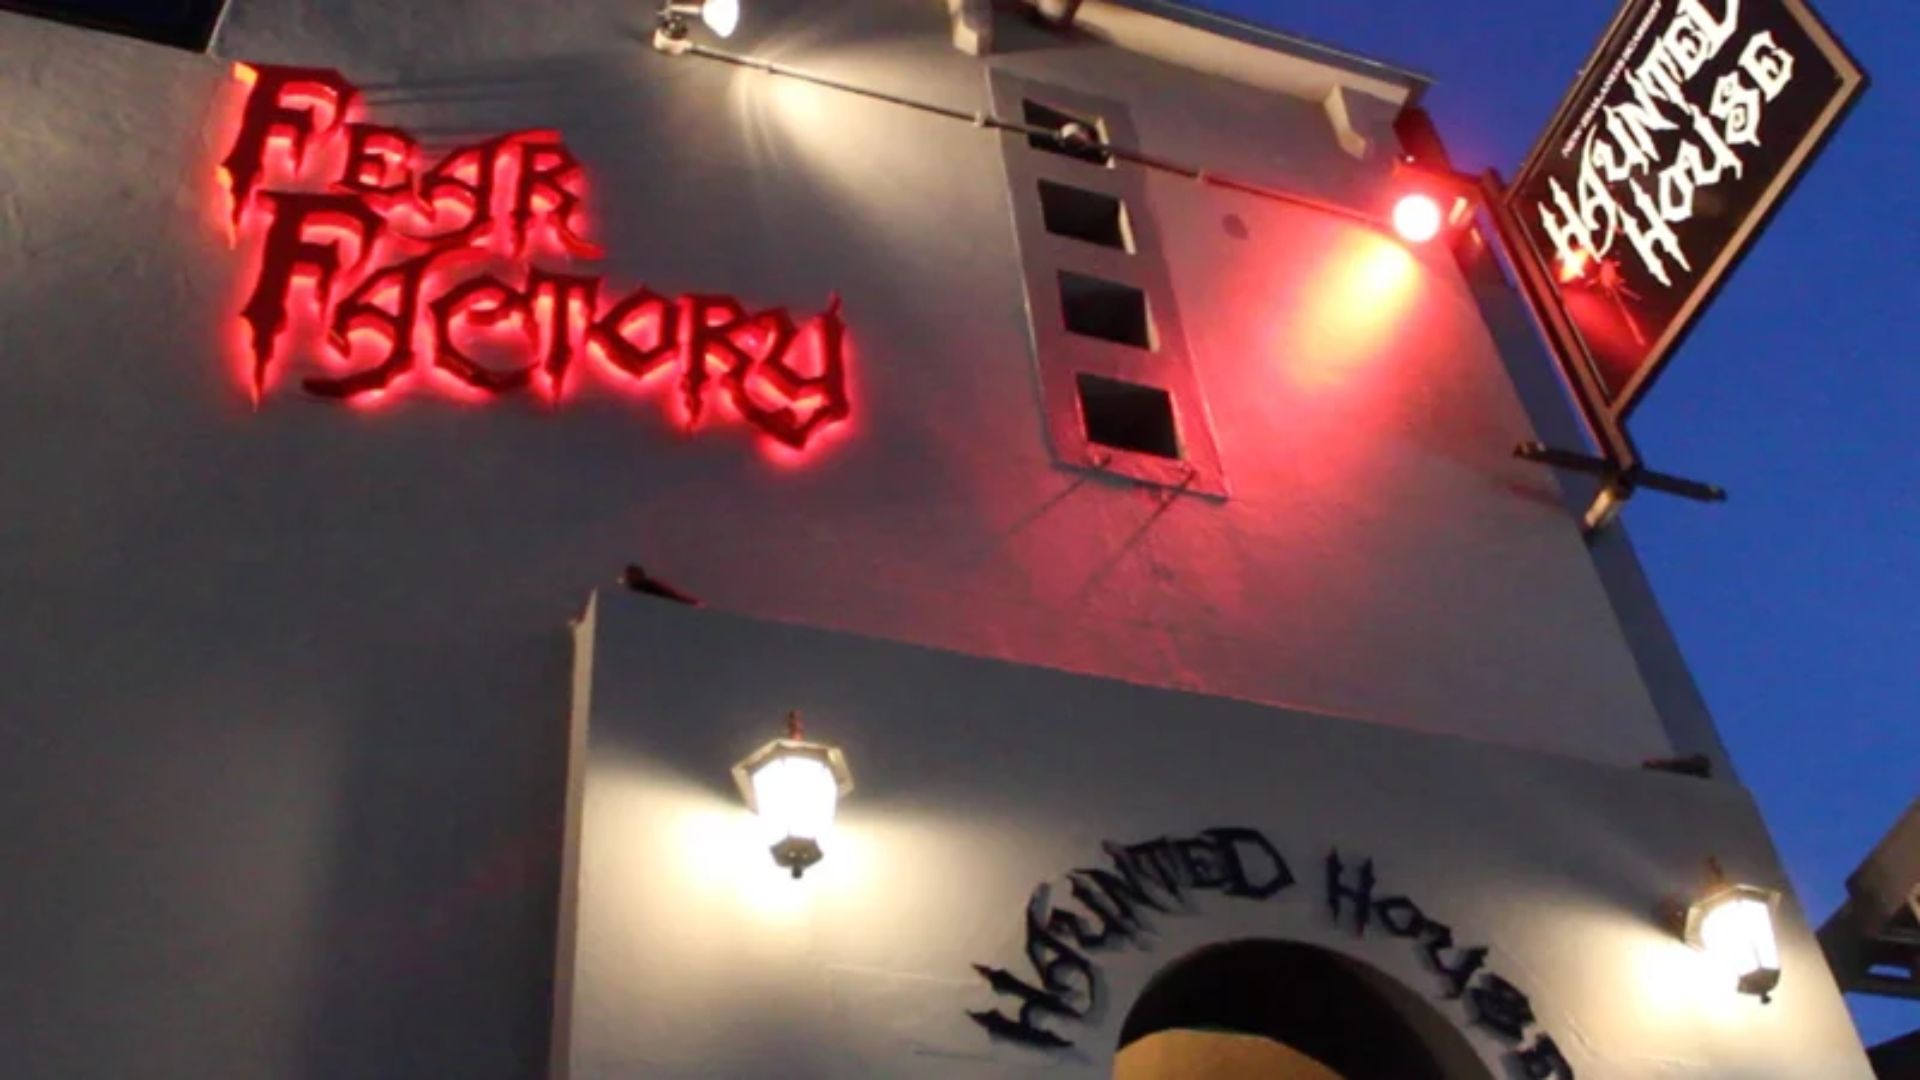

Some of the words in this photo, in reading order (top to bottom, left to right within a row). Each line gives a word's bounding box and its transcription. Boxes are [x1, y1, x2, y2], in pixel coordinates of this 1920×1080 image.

[220, 62, 604, 248] FEAR
[1537, 0, 1742, 274] HAUNTED
[1616, 30, 1795, 287] HOUSE
[240, 190, 852, 452] FACTORY
[966, 827, 1296, 1048] HAUNTED
